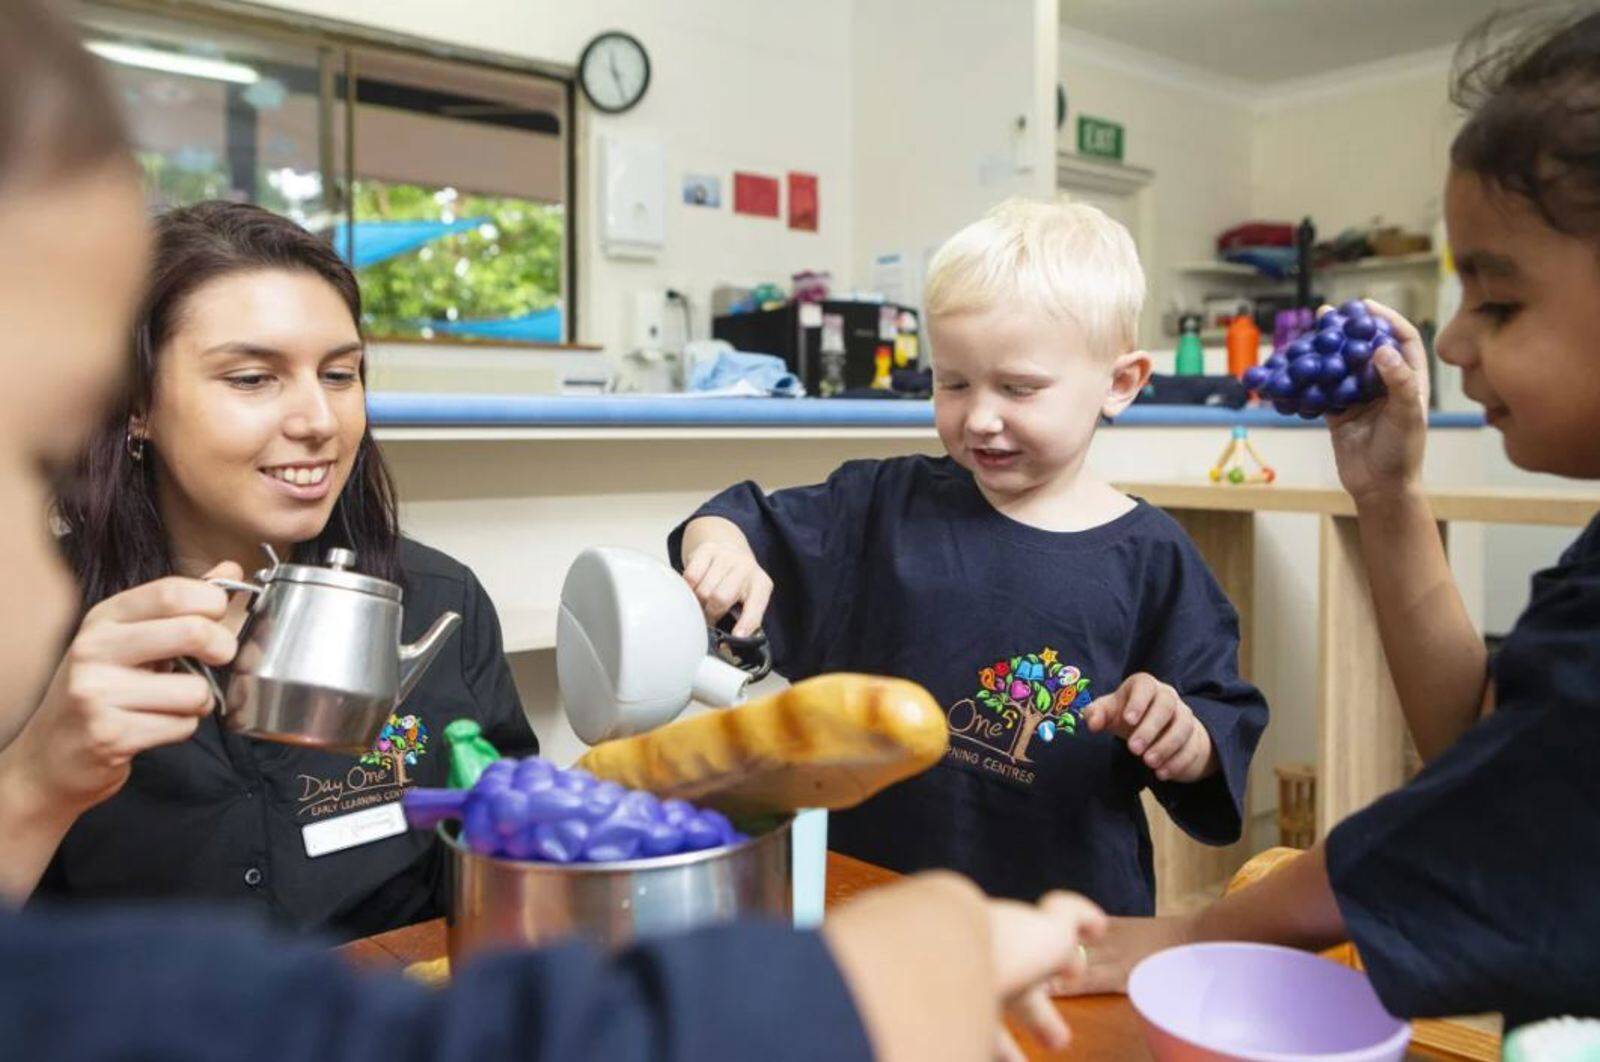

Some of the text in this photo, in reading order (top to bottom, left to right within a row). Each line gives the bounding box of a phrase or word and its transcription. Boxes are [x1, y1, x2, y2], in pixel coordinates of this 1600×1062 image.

[1083, 122, 1115, 152] EXIT
[948, 698, 1003, 737] One
[298, 766, 386, 801] Day One
[984, 757, 1036, 784] CENTRES
[311, 800, 339, 816] EARLY
[342, 793, 382, 809] LEARNING
